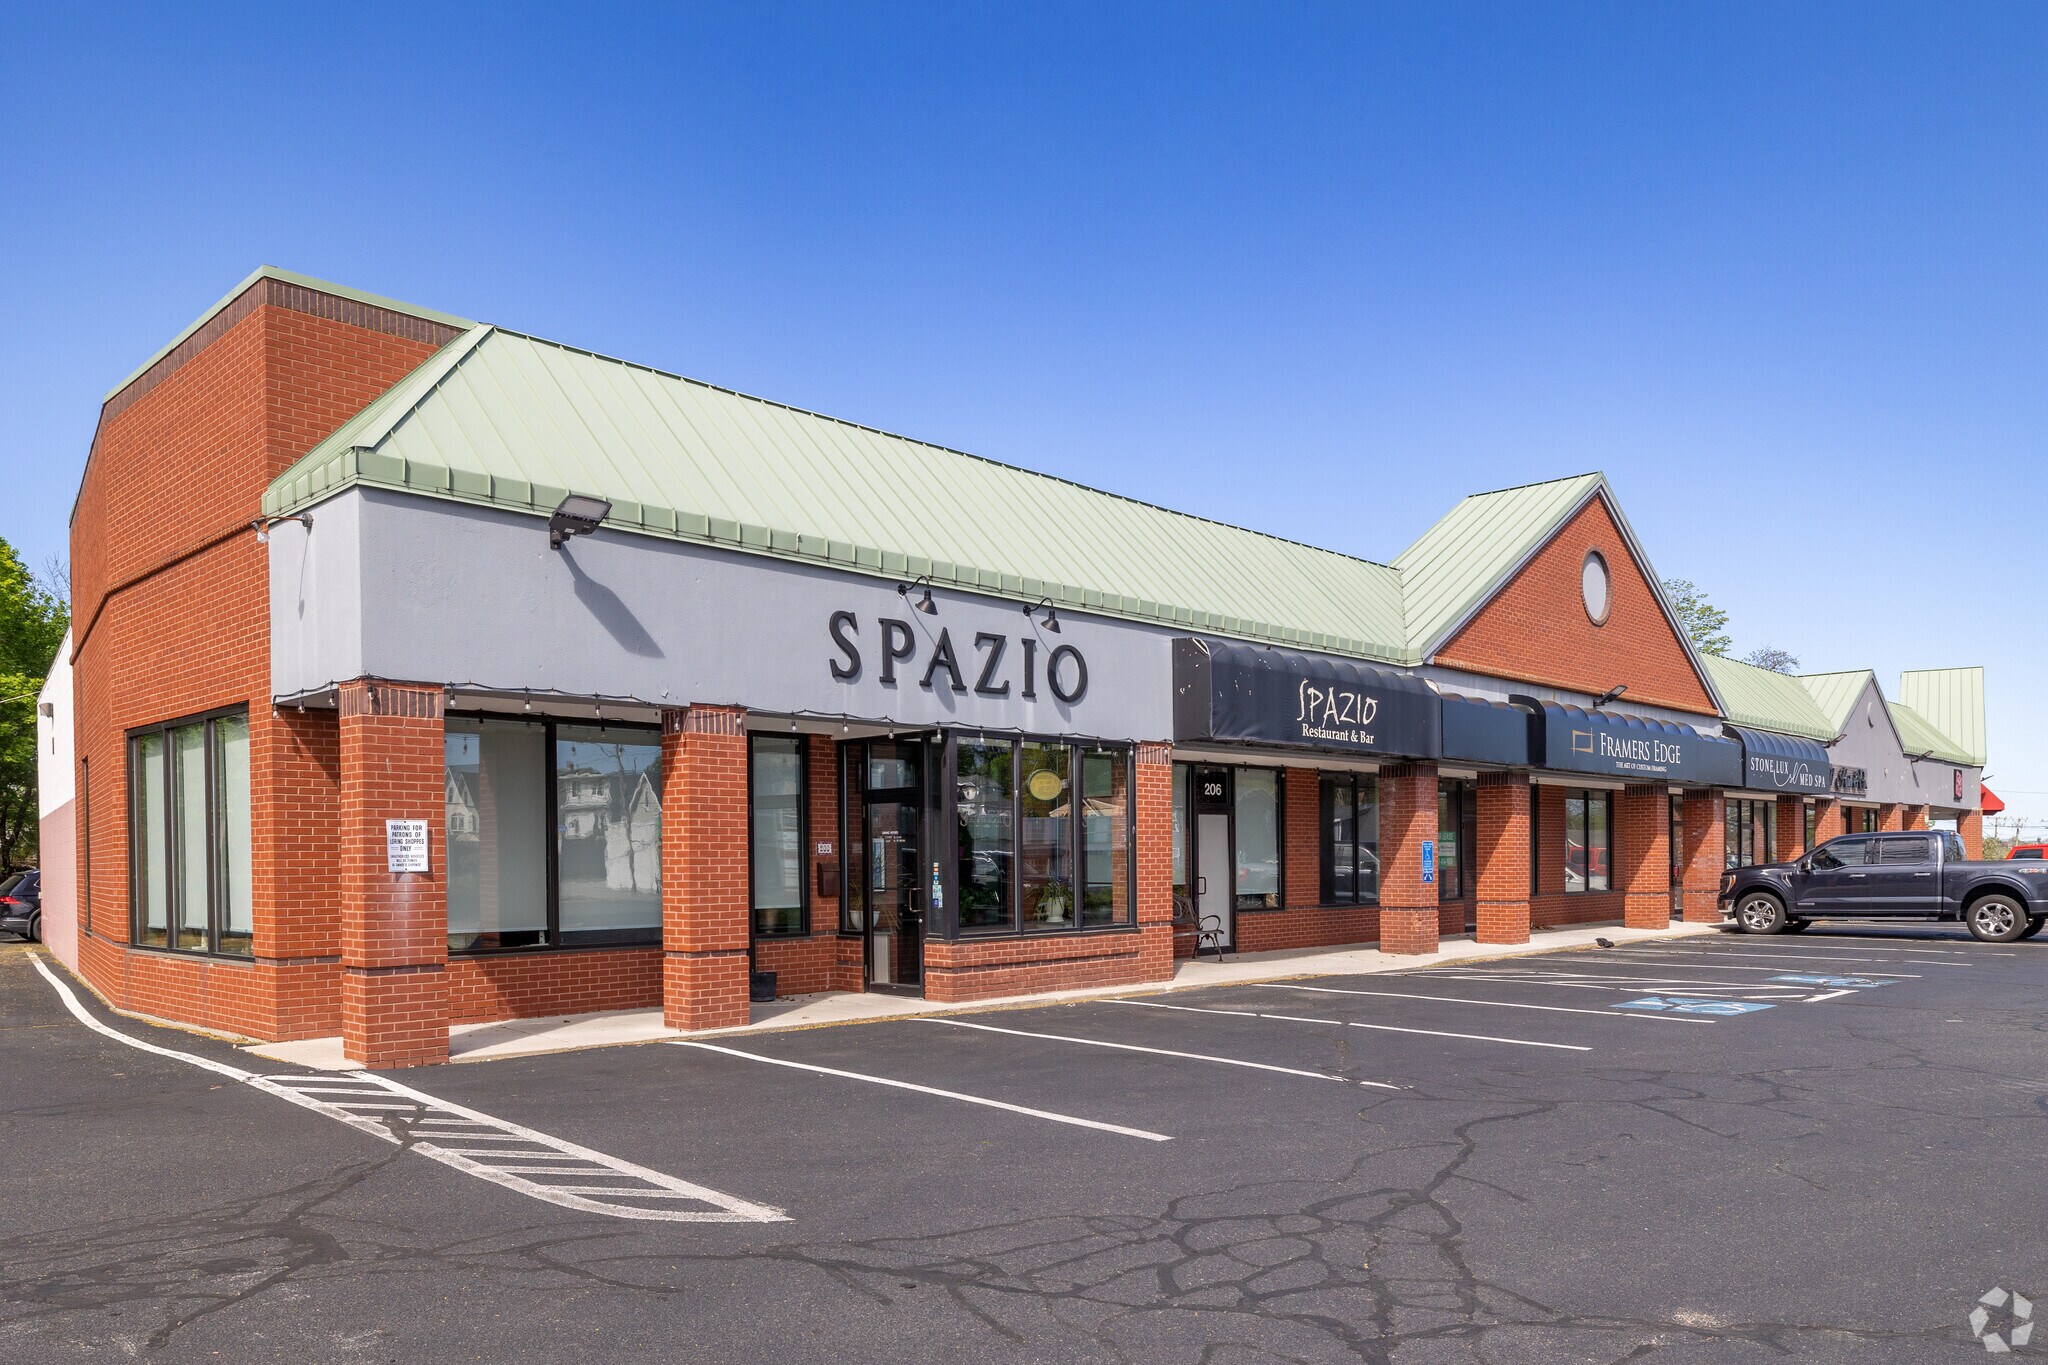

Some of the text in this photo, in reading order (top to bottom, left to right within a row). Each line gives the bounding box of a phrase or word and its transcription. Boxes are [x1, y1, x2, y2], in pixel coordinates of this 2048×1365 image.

[829, 610, 1088, 703] SPAZIO
[1296, 677, 1379, 728] SPAZIO
[1302, 723, 1375, 744] Restaurant & Bar
[1599, 732, 1681, 764] FRAMERS EDGE
[1750, 756, 1789, 775] STONE LUX
[1204, 783, 1222, 796] 206
[1799, 773, 1813, 787] MED
[1814, 775, 1826, 788] SPA
